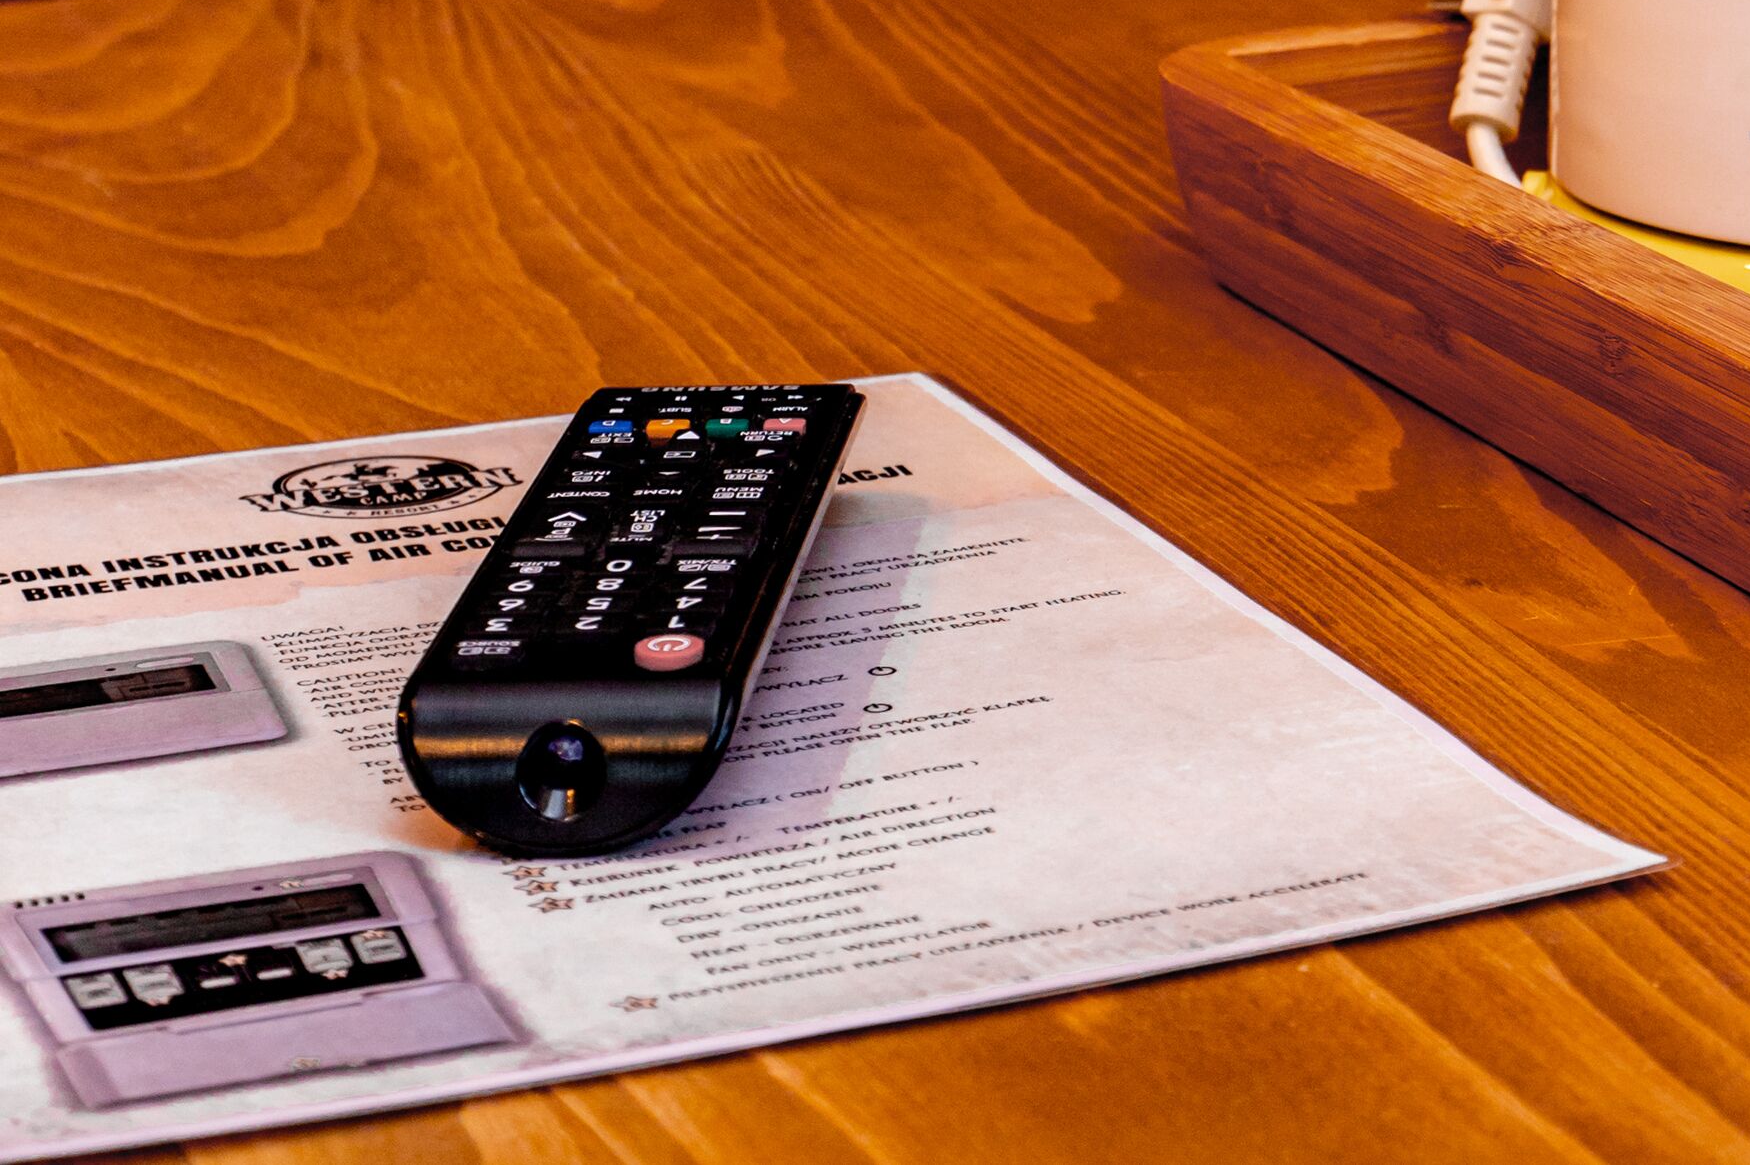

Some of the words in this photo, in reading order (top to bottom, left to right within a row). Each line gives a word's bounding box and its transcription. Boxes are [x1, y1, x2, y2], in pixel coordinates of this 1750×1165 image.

[239, 467, 524, 512] WESTERN
[360, 491, 428, 506] CAMP
[547, 491, 610, 499] CONTENT
[102, 535, 341, 573] INSTRUKCJA
[350, 517, 506, 544] OBSŁUGI
[838, 465, 913, 485] ACJI
[370, 504, 440, 517] RESORT
[22, 559, 300, 602] BRIEFMANUAL
[308, 551, 354, 568] OF
[369, 543, 432, 562] AIR
[441, 535, 500, 553] CO
[606, 559, 633, 573] 0
[801, 565, 835, 575] ZWI
[852, 556, 903, 569] OKNA
[508, 579, 535, 593] 9
[596, 578, 624, 591] 8
[683, 577, 708, 590] 7
[797, 575, 822, 584] CH
[830, 567, 882, 580] PRACY
[499, 598, 526, 612] 6
[585, 597, 613, 611] 5
[676, 596, 703, 609] 4
[825, 615, 855, 623] ALL
[858, 603, 922, 617] DOORS
[485, 617, 513, 632] 3
[574, 616, 602, 630] 2
[667, 615, 685, 629] 1
[786, 629, 858, 645] APPROX.
[878, 616, 957, 631] MINUTES
[960, 611, 986, 619] TO
[990, 602, 1040, 615] START
[1045, 589, 1126, 606] HEATING.
[261, 625, 345, 641] UWAGA!
[832, 632, 905, 647] LEAVING
[908, 626, 944, 634] THE
[949, 617, 1011, 630] ROOM.
[279, 656, 309, 664] OD
[315, 641, 415, 659] MOMENTU
[297, 667, 404, 686] CAUTION!
[310, 692, 352, 702] AND
[359, 685, 401, 694] WIN
[760, 702, 845, 719] LOCATED
[759, 712, 837, 729] BUTTON
[762, 742, 825, 757] PLEASE
[829, 733, 882, 746] OPEN
[887, 726, 926, 736] THE
[931, 718, 975, 730] FLAP.
[360, 760, 391, 768] TO
[382, 777, 403, 785] BY
[838, 778, 874, 789] OFF
[882, 762, 964, 781] BUTTON
[394, 804, 426, 812] TO
[776, 803, 920, 835] TEMPERATURE
[557, 842, 708, 870] TEMPERATURA
[569, 864, 680, 887] KIERUNEK
[694, 842, 815, 867] POWIETRZA
[839, 830, 876, 842] AIR
[882, 807, 997, 834] DIRECTION
[583, 884, 672, 903] ZMIANA
[677, 870, 744, 888] TRYBU
[836, 843, 902, 861] MODE
[907, 826, 997, 847] CHANGE
[724, 862, 898, 898] AUTOMATYCZNY
[853, 951, 923, 970] PRACY
[1092, 908, 1171, 928] DEVICE
[1176, 895, 1242, 912] WORK
[1248, 872, 1369, 899] ACCELERATE
[676, 930, 722, 944] DRY
[690, 943, 749, 960] HEAT
[774, 915, 921, 946] OGRZEWANIE
[705, 962, 749, 976] FAN
[757, 951, 818, 967] ONLY
[841, 921, 992, 953] WENTYLATOR
